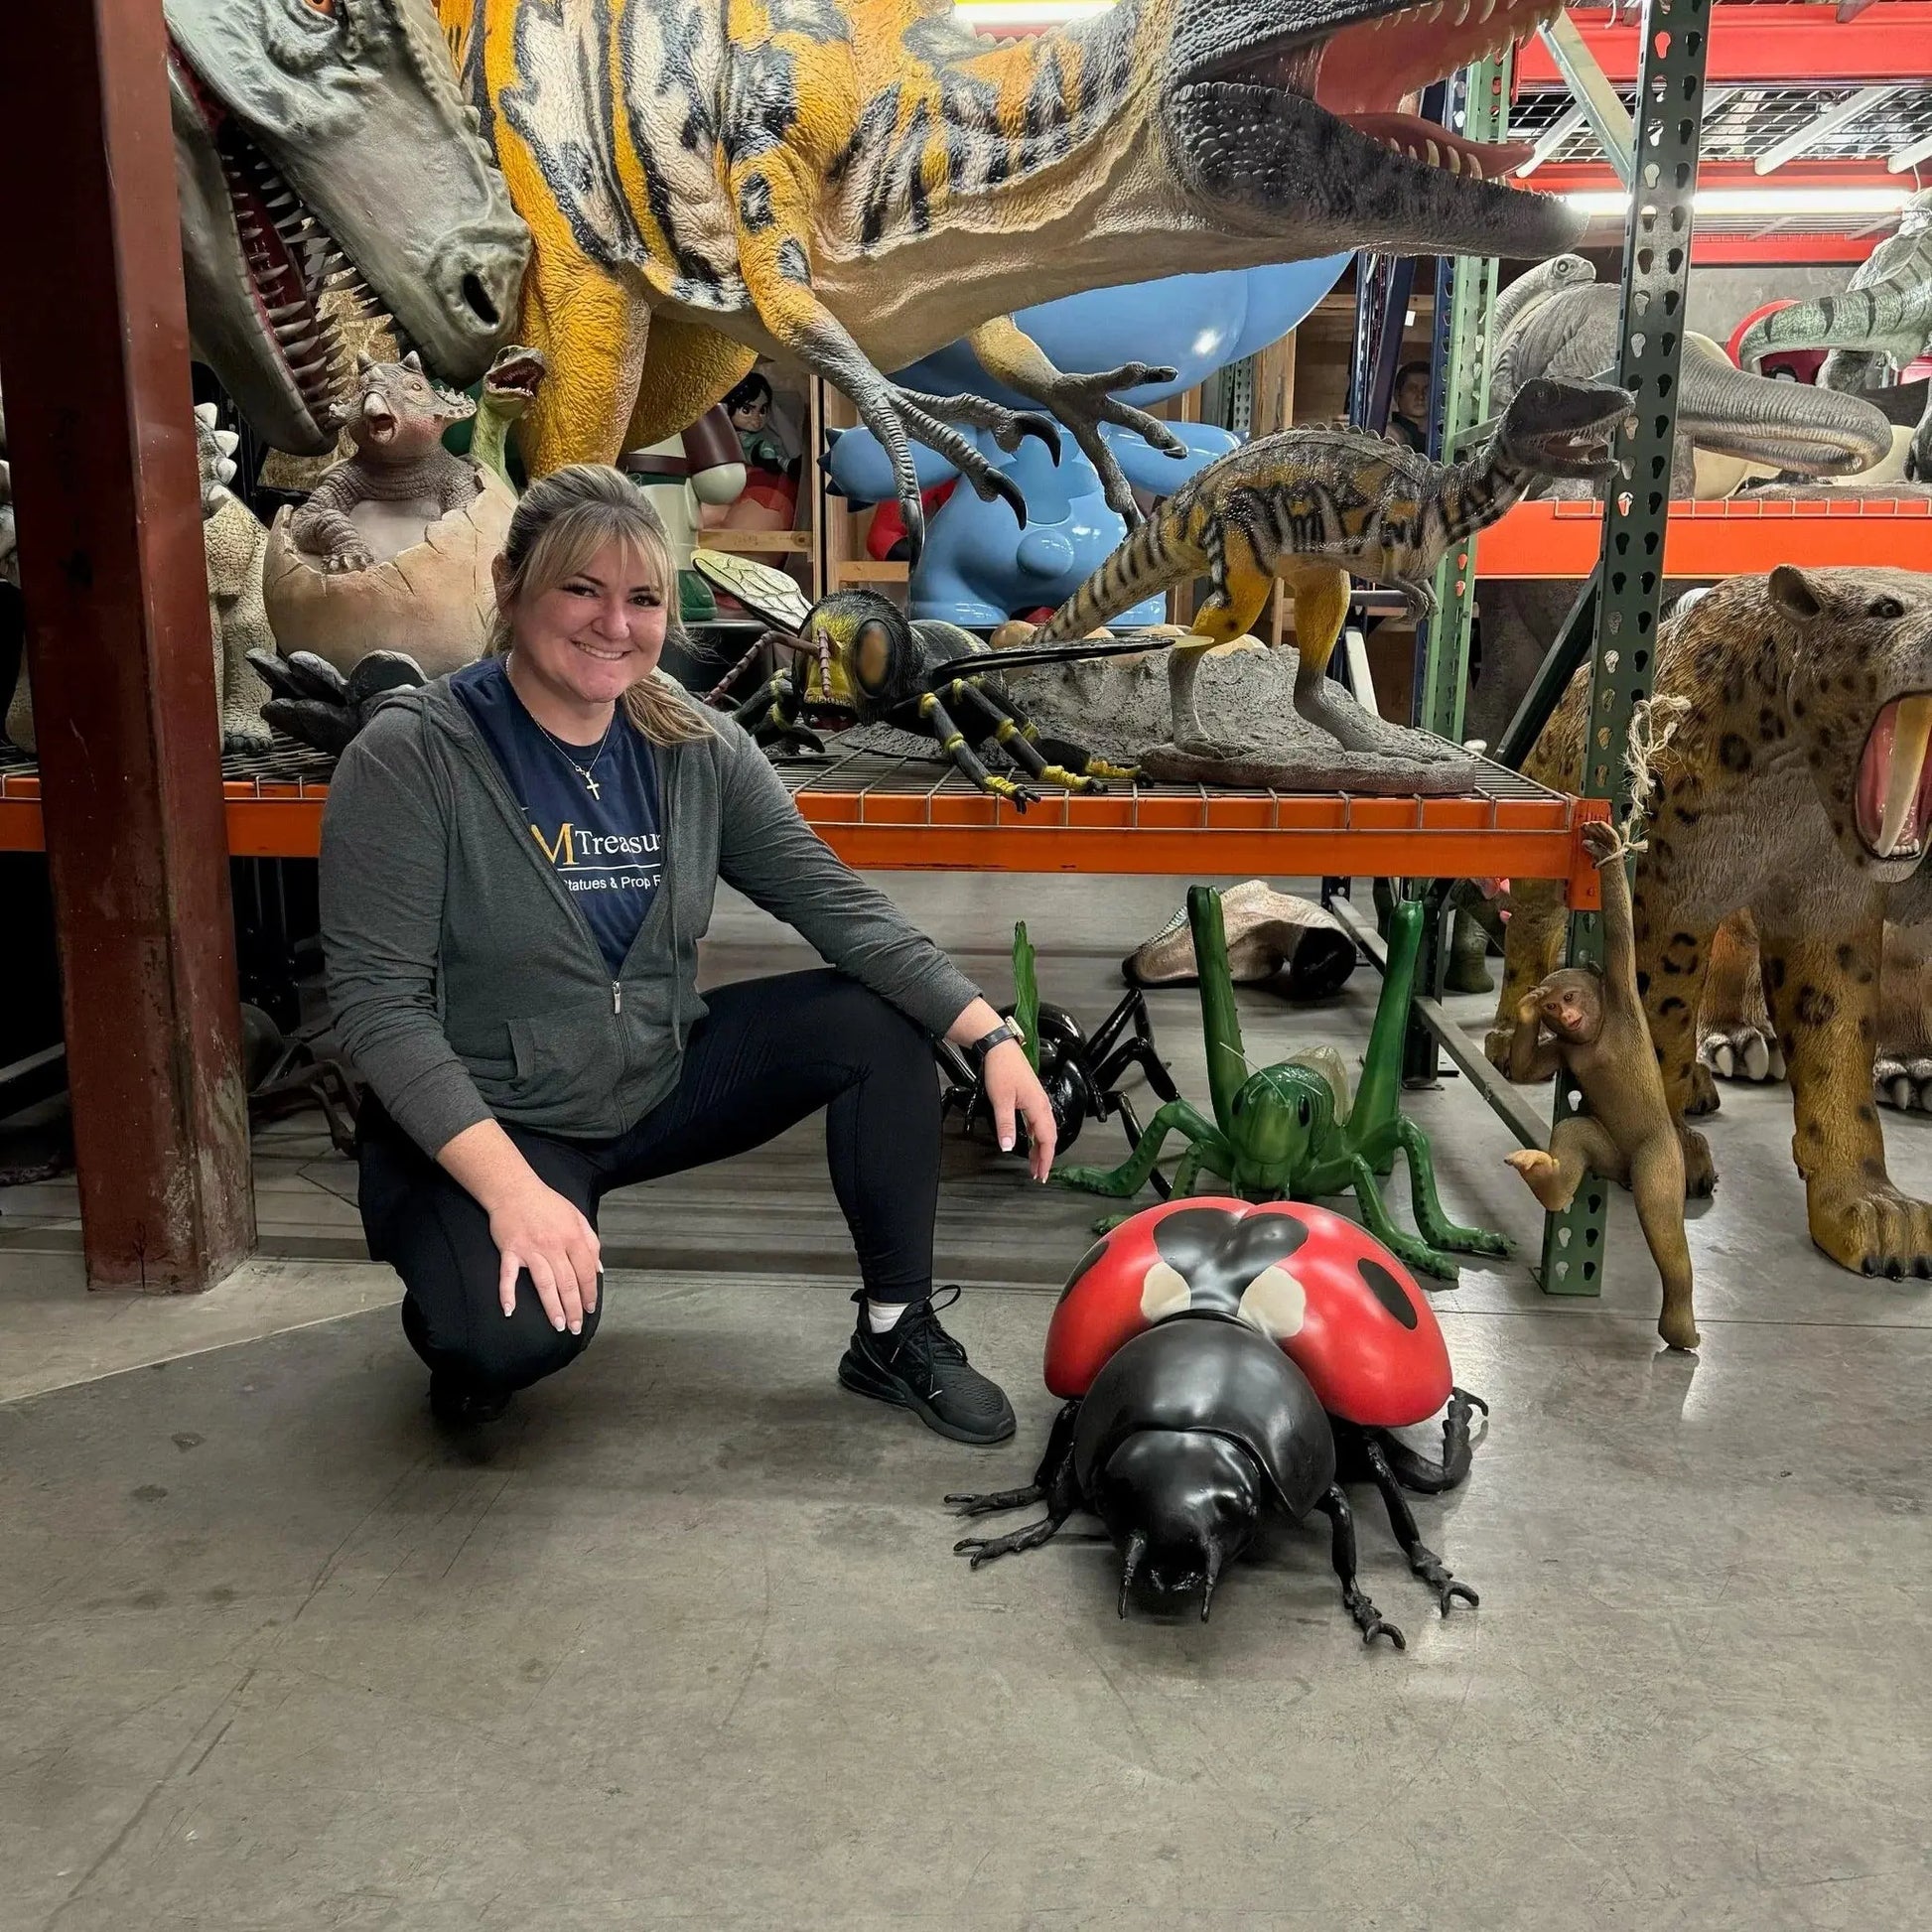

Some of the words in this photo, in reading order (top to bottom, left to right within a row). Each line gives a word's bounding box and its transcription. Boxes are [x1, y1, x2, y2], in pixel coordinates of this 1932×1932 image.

[564, 879, 607, 892] tatues
[610, 877, 618, 890] &
[621, 876, 651, 890] Prop
